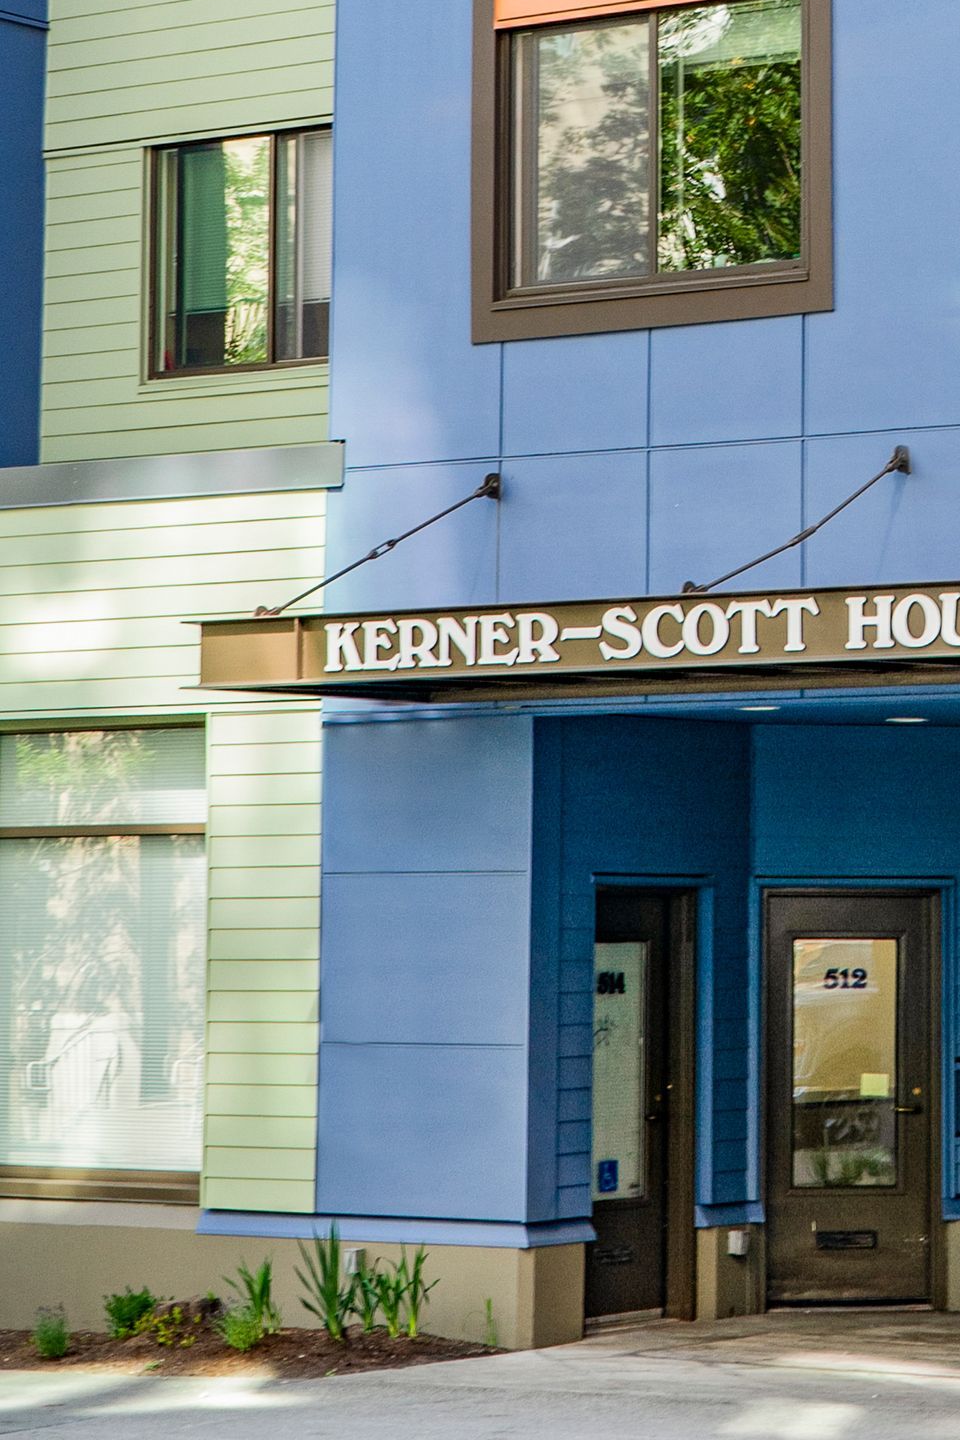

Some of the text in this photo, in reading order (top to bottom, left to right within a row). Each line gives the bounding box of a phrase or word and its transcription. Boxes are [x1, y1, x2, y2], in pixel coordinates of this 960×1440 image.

[323, 596, 821, 673] KERNER-SCOTT
[597, 971, 626, 995] 514
[824, 968, 868, 990] 512
